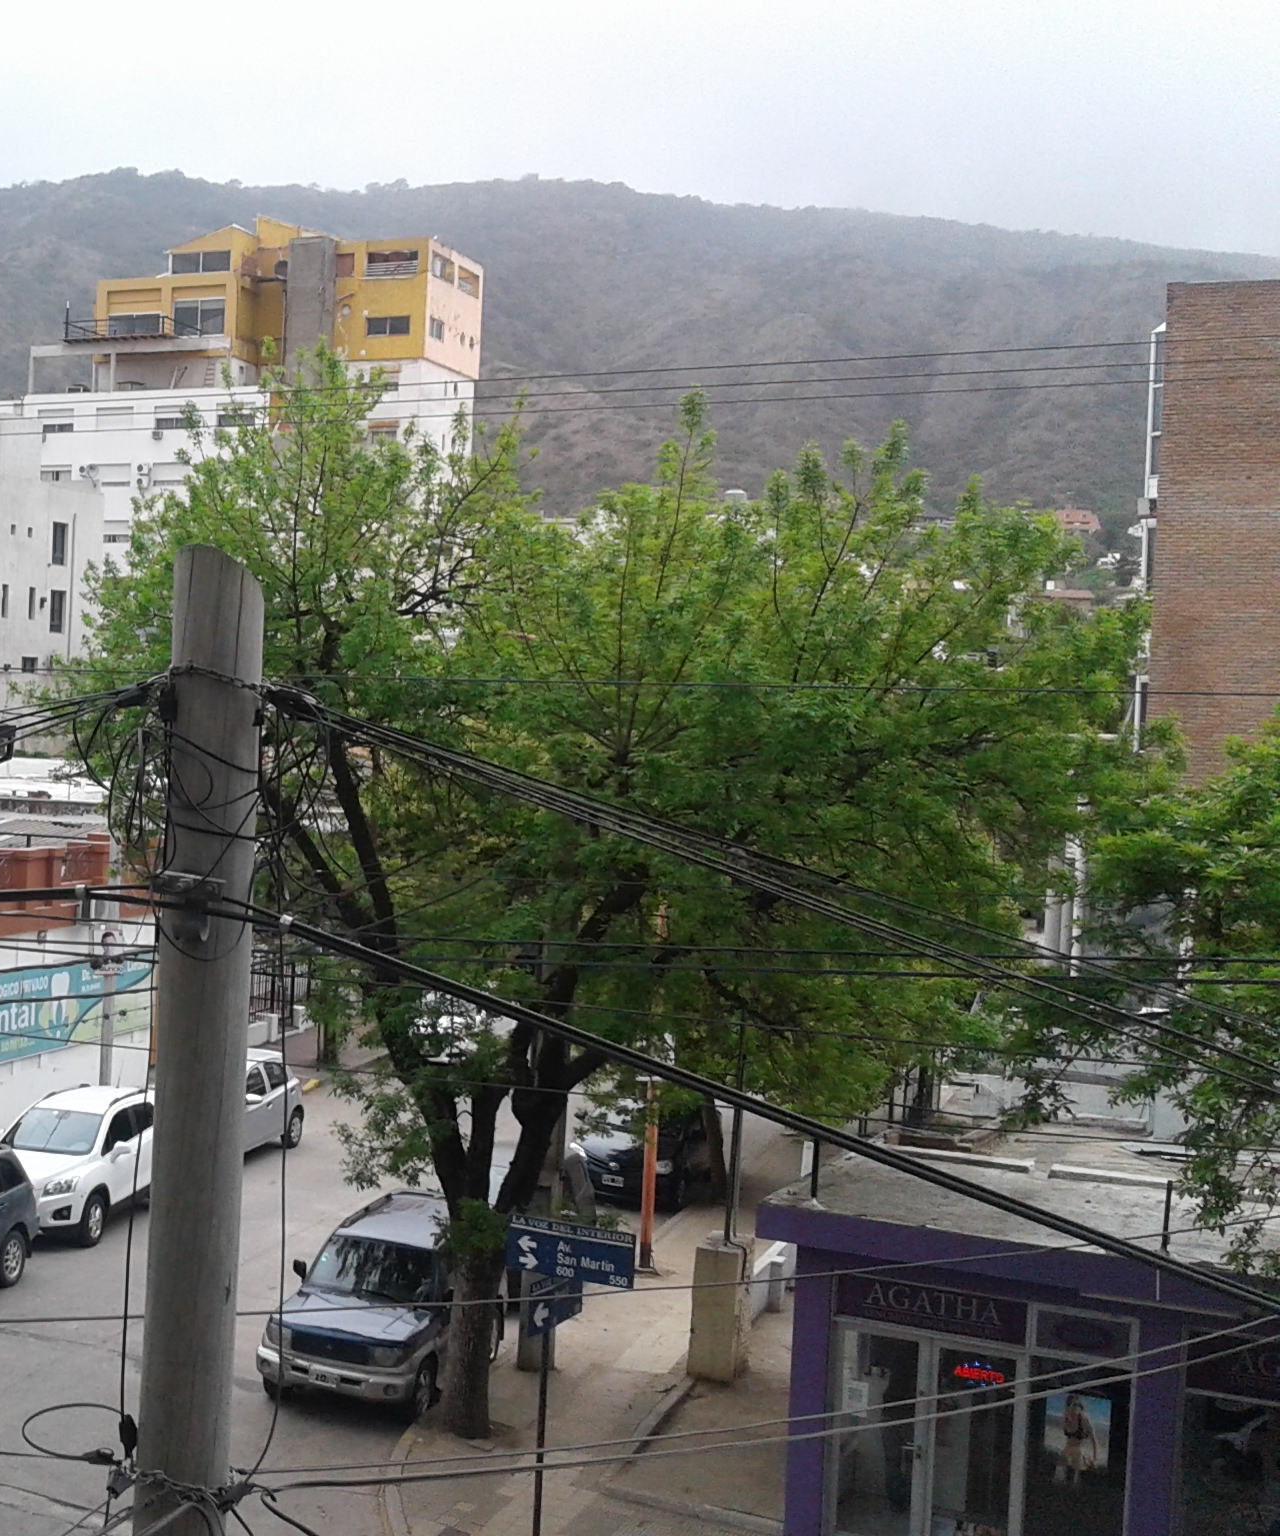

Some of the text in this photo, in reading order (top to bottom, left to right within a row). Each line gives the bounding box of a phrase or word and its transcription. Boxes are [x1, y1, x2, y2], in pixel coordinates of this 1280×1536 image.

[512, 1215, 634, 1243] LA VOZ DEL INTERIOR
[557, 1240, 572, 1253] Av.
[556, 1253, 577, 1267] San
[555, 1267, 575, 1278] 600
[608, 1275, 628, 1286] 550
[864, 1282, 1002, 1325] AGATHA
[954, 1365, 1005, 1385] ABIERTO
